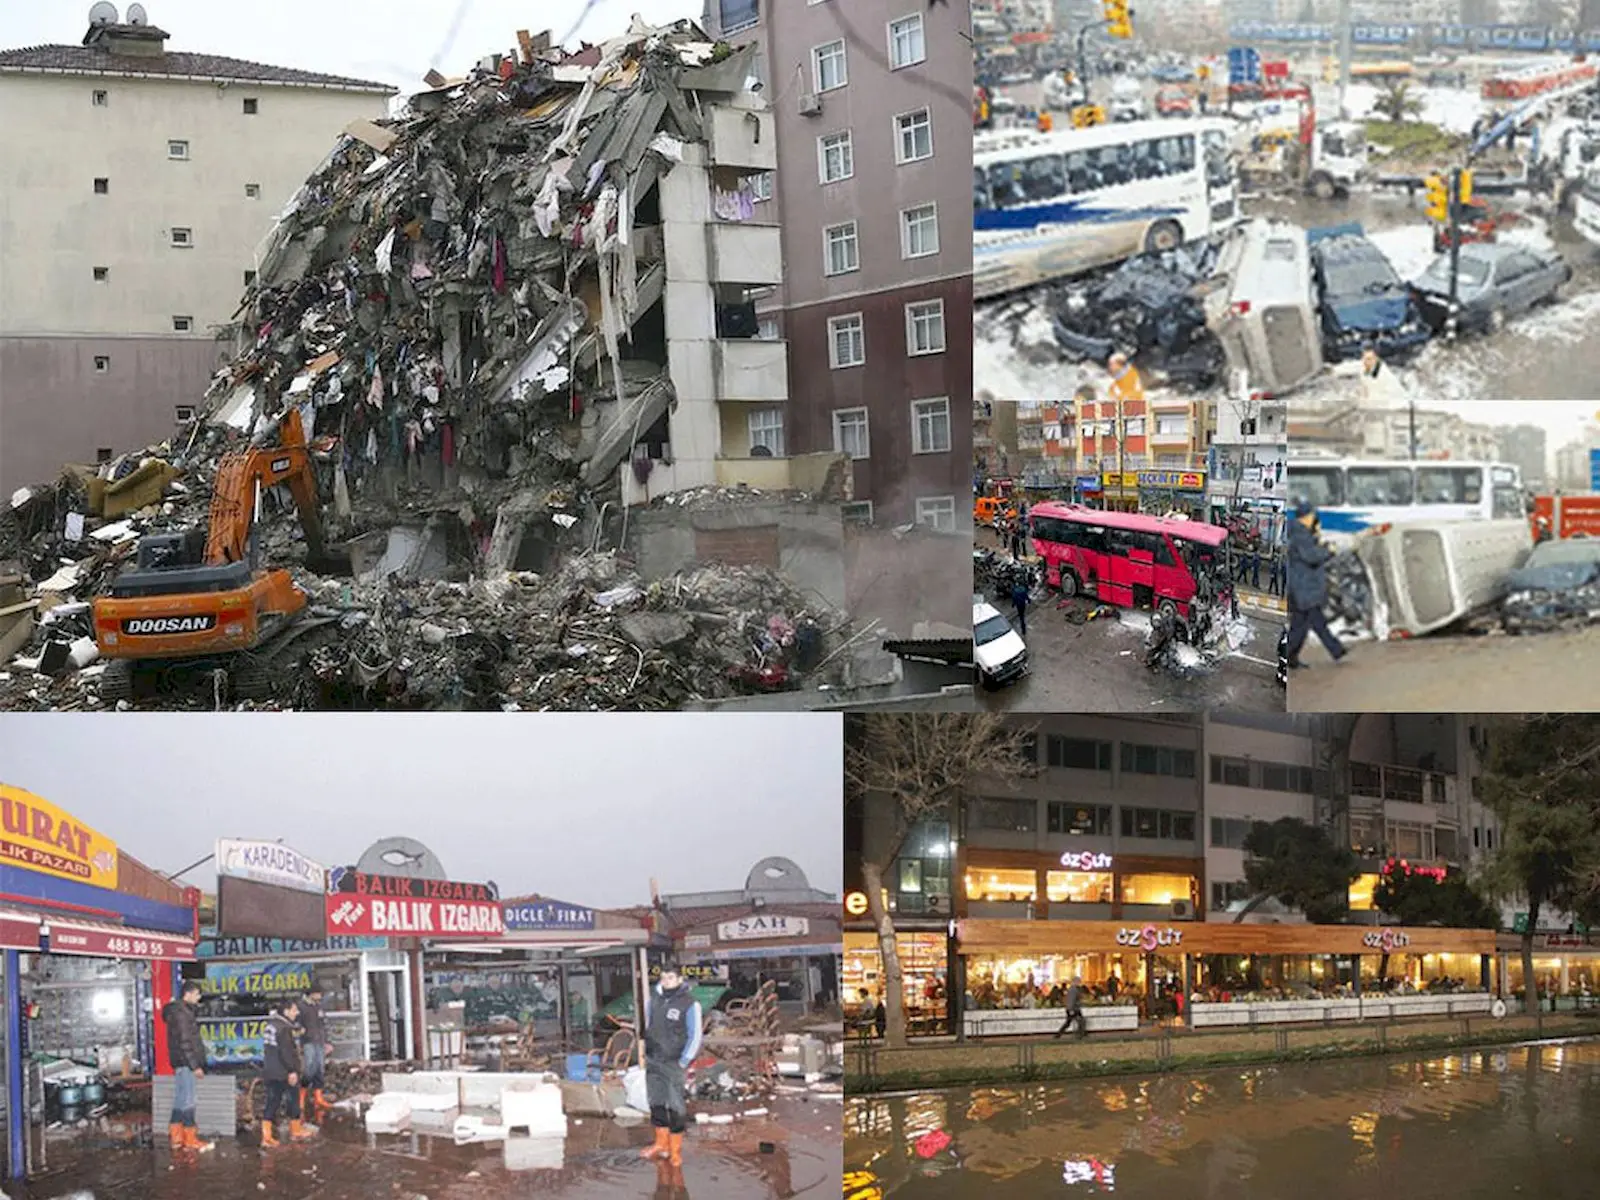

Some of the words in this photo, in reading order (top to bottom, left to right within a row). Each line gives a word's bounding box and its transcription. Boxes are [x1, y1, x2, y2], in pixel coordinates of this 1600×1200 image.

[126, 617, 208, 634] DOOSAN
[355, 873, 412, 897] BALIK
[371, 899, 435, 932] BALIK
[439, 902, 503, 932] IZGARA
[214, 936, 273, 956] BALIK
